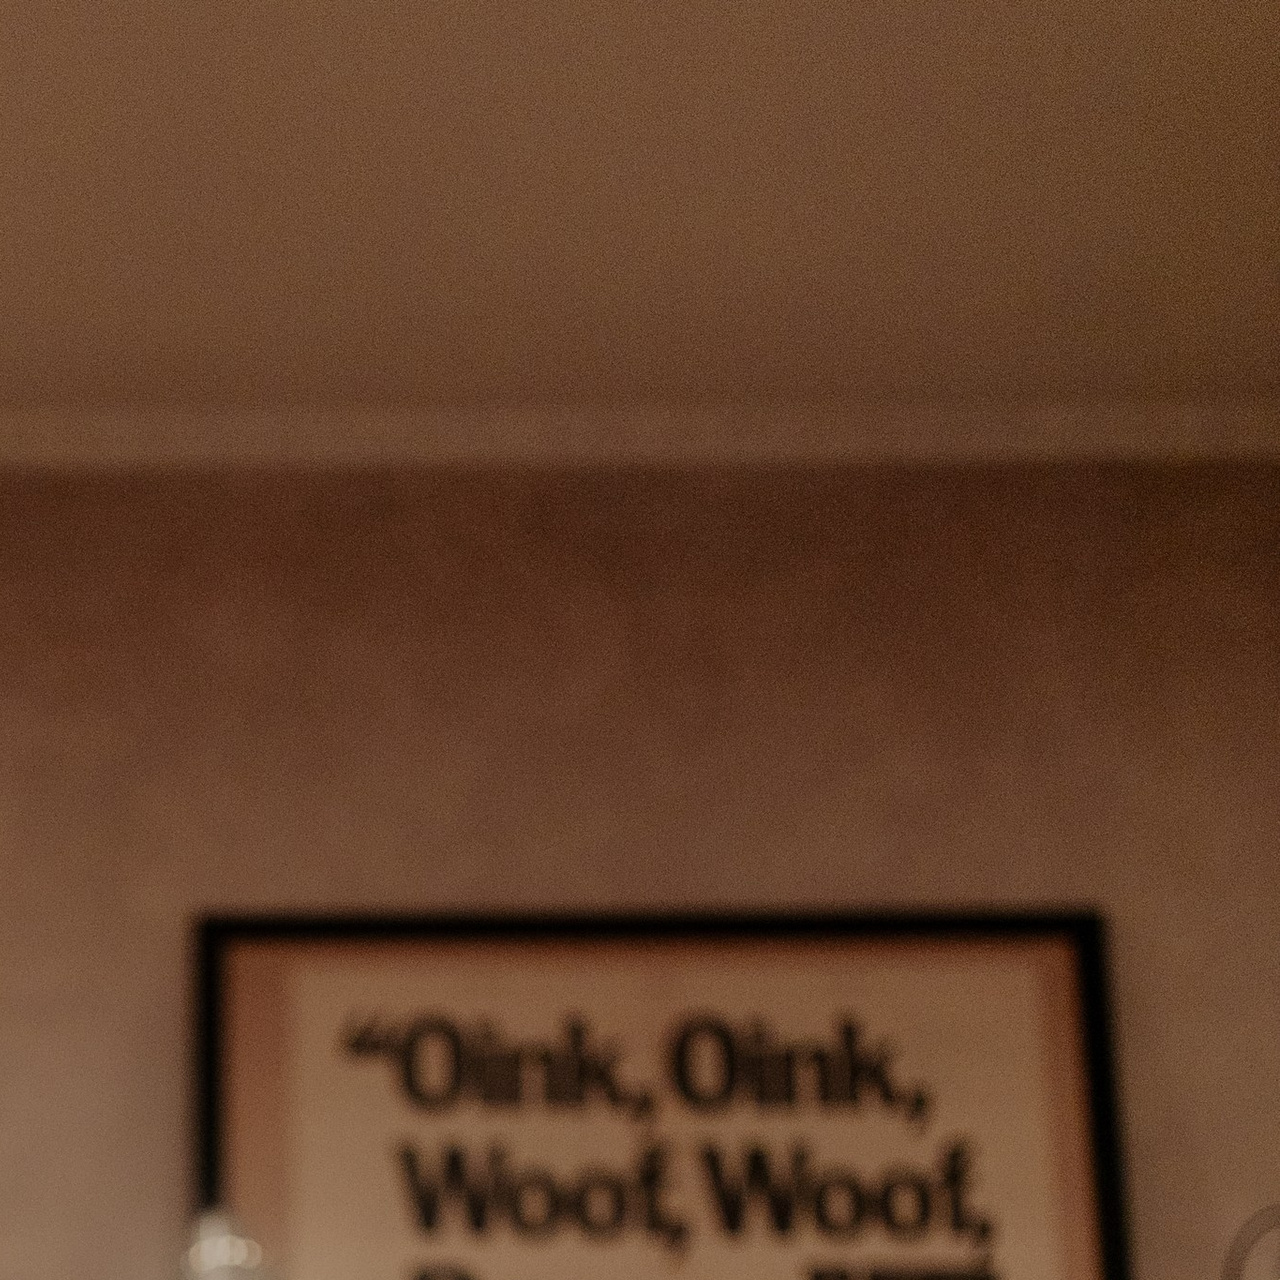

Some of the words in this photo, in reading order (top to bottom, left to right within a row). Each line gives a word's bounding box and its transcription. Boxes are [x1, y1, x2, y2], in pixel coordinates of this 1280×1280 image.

[669, 1012, 928, 1130] Oink,
[398, 1140, 689, 1258] Woof,
[698, 1140, 996, 1250] Woof,
